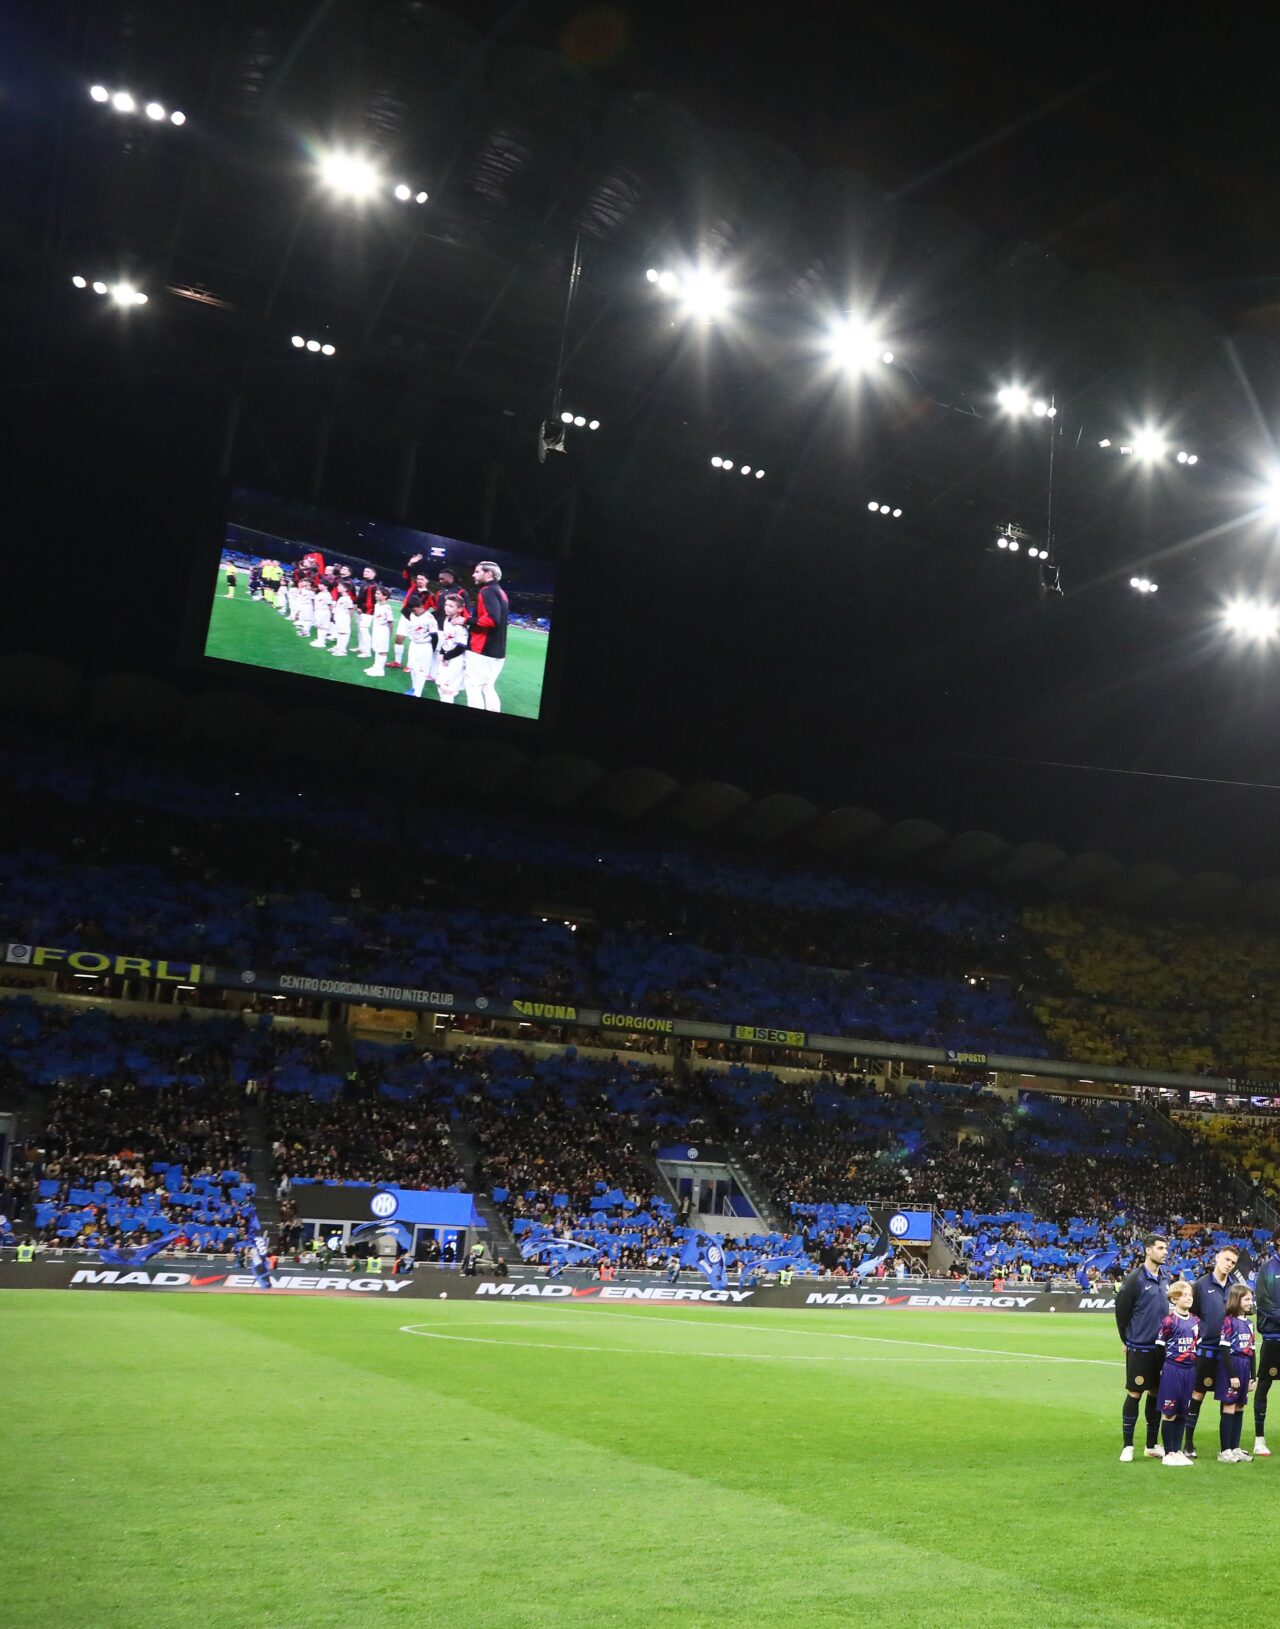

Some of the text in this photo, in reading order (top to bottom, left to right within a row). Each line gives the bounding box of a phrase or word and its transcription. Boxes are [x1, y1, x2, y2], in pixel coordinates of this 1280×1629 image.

[32, 946, 201, 983] FORLI
[280, 975, 453, 1005] CENTRO COORDINAMENTO INTER CLUB
[512, 1000, 577, 1020] SAVONA
[602, 1012, 673, 1033] GIORGIONE
[753, 1028, 787, 1042] ISEO
[71, 1270, 415, 1292] MAD ENERGY
[475, 1282, 754, 1302] MAD ENERGY
[806, 1292, 1036, 1308] MAD ENERGY
[1079, 1298, 1116, 1309] MA
